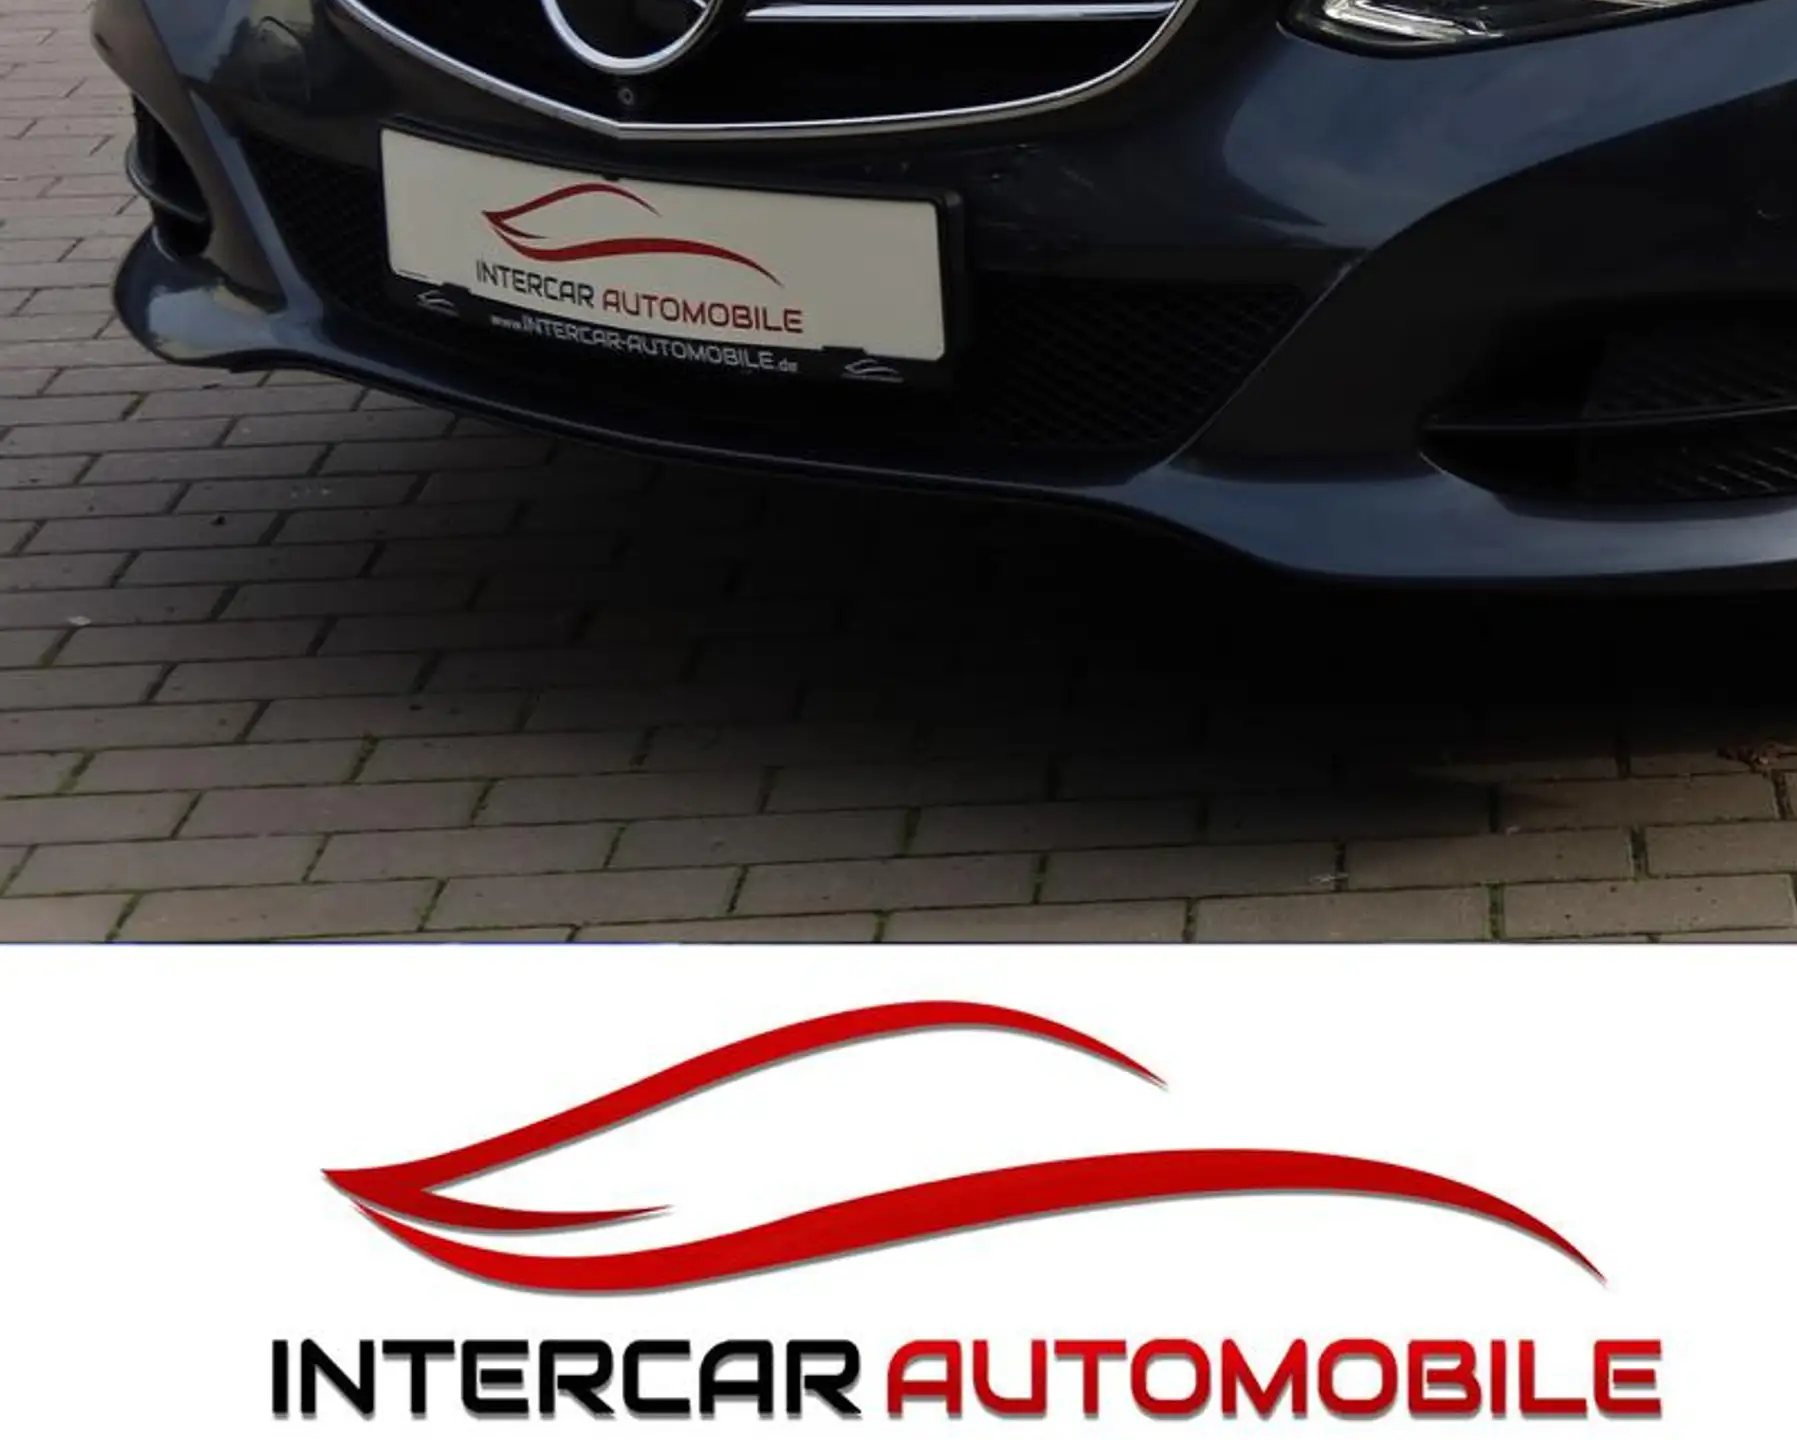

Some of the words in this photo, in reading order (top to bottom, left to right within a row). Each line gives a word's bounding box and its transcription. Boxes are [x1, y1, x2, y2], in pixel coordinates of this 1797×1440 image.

[476, 258, 595, 309] INTERCAR
[602, 288, 804, 334] AUTOMOBILE
[490, 313, 798, 373] www.INTERCAR-AUTOMOBILE.de
